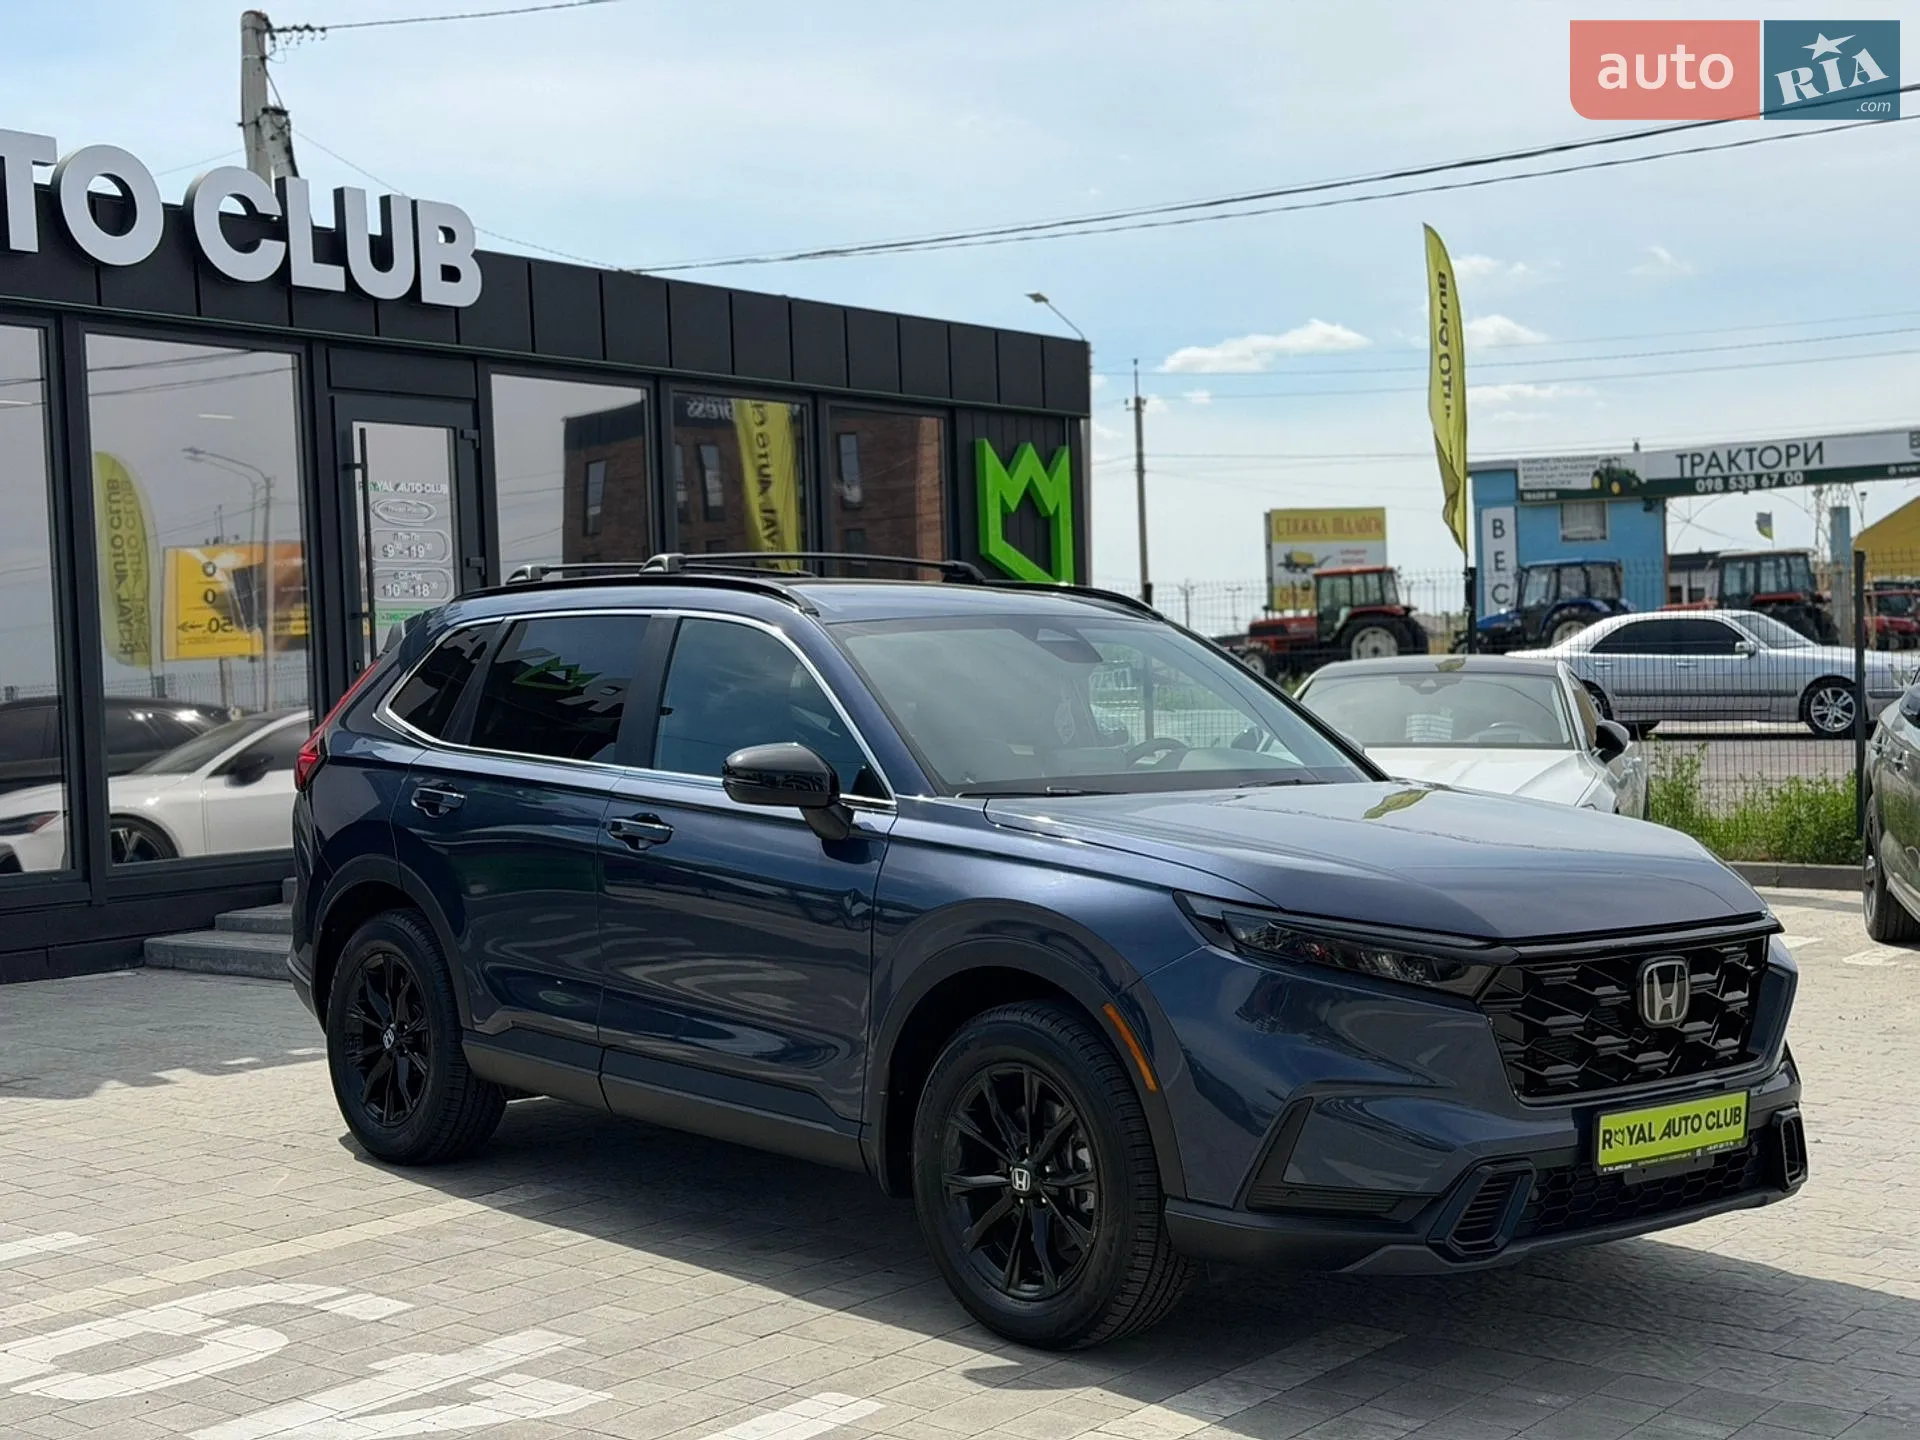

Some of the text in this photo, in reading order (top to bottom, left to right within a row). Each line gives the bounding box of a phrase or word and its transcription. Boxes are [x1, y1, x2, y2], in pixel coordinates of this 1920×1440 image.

[192, 165, 483, 308] CLUB
[1675, 441, 1824, 477] ТРАКТОРИ
[1695, 471, 1804, 492] 098 538 67 00
[1492, 518, 1510, 605] ВЕС
[1659, 1113, 1700, 1140] AUTO
[1705, 1106, 1742, 1132] CLUB
